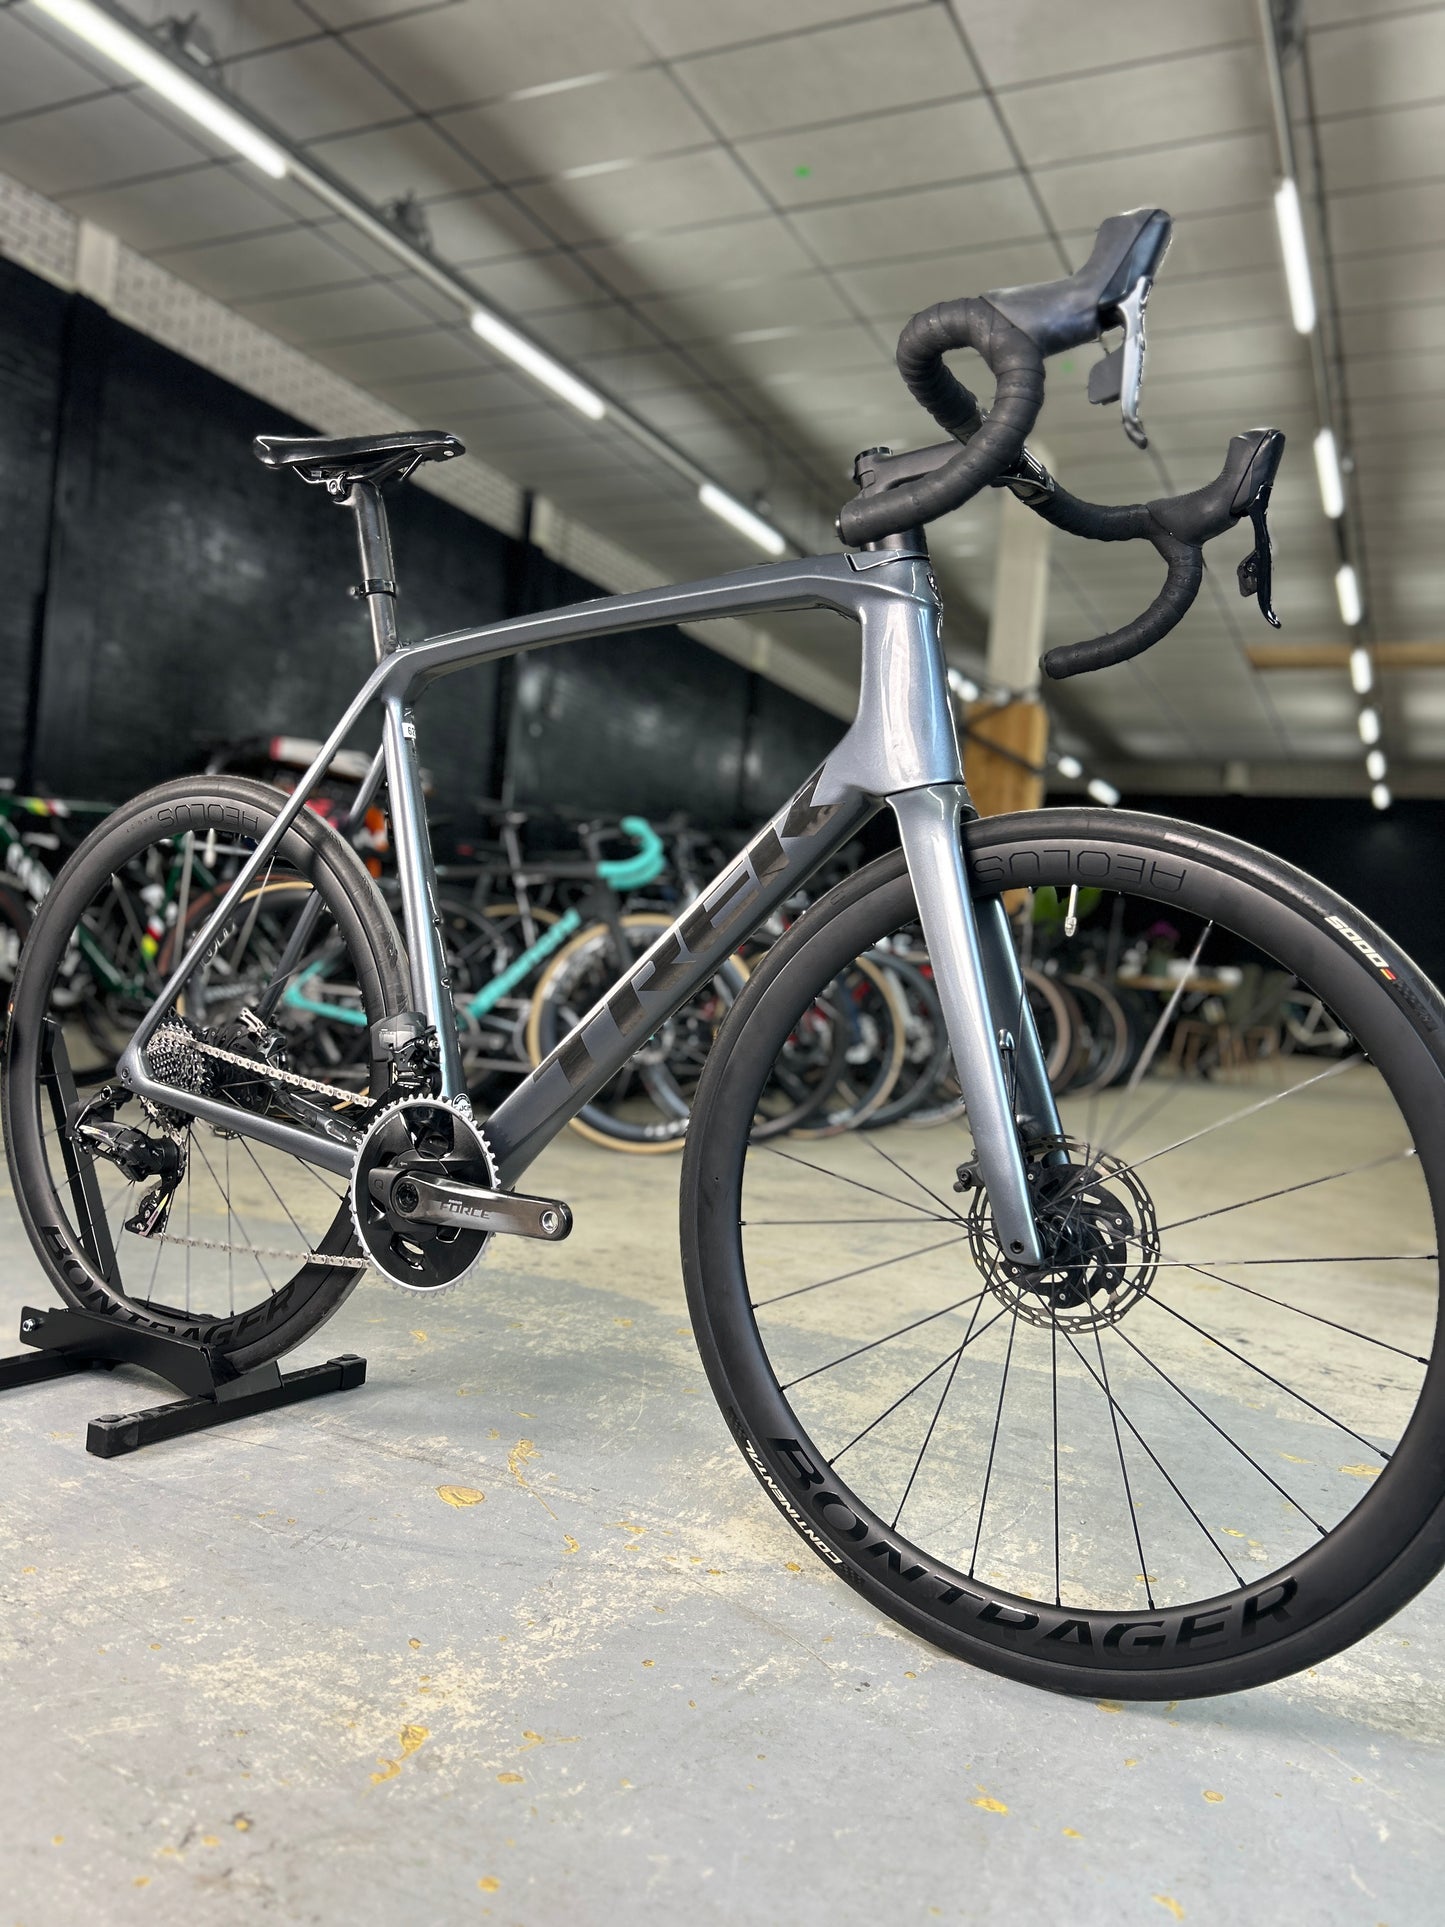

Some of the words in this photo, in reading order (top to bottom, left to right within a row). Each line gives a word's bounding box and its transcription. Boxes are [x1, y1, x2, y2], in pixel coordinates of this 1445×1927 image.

[157, 804, 259, 832] AEOLUS
[973, 850, 1187, 892] AEOLUS
[533, 762, 845, 1087] TREK
[1324, 915, 1390, 968] 5000
[440, 1202, 490, 1220] FORCE
[745, 1439, 843, 1565] CONTINENTAL
[766, 1437, 1298, 1657] BONTRAGER
